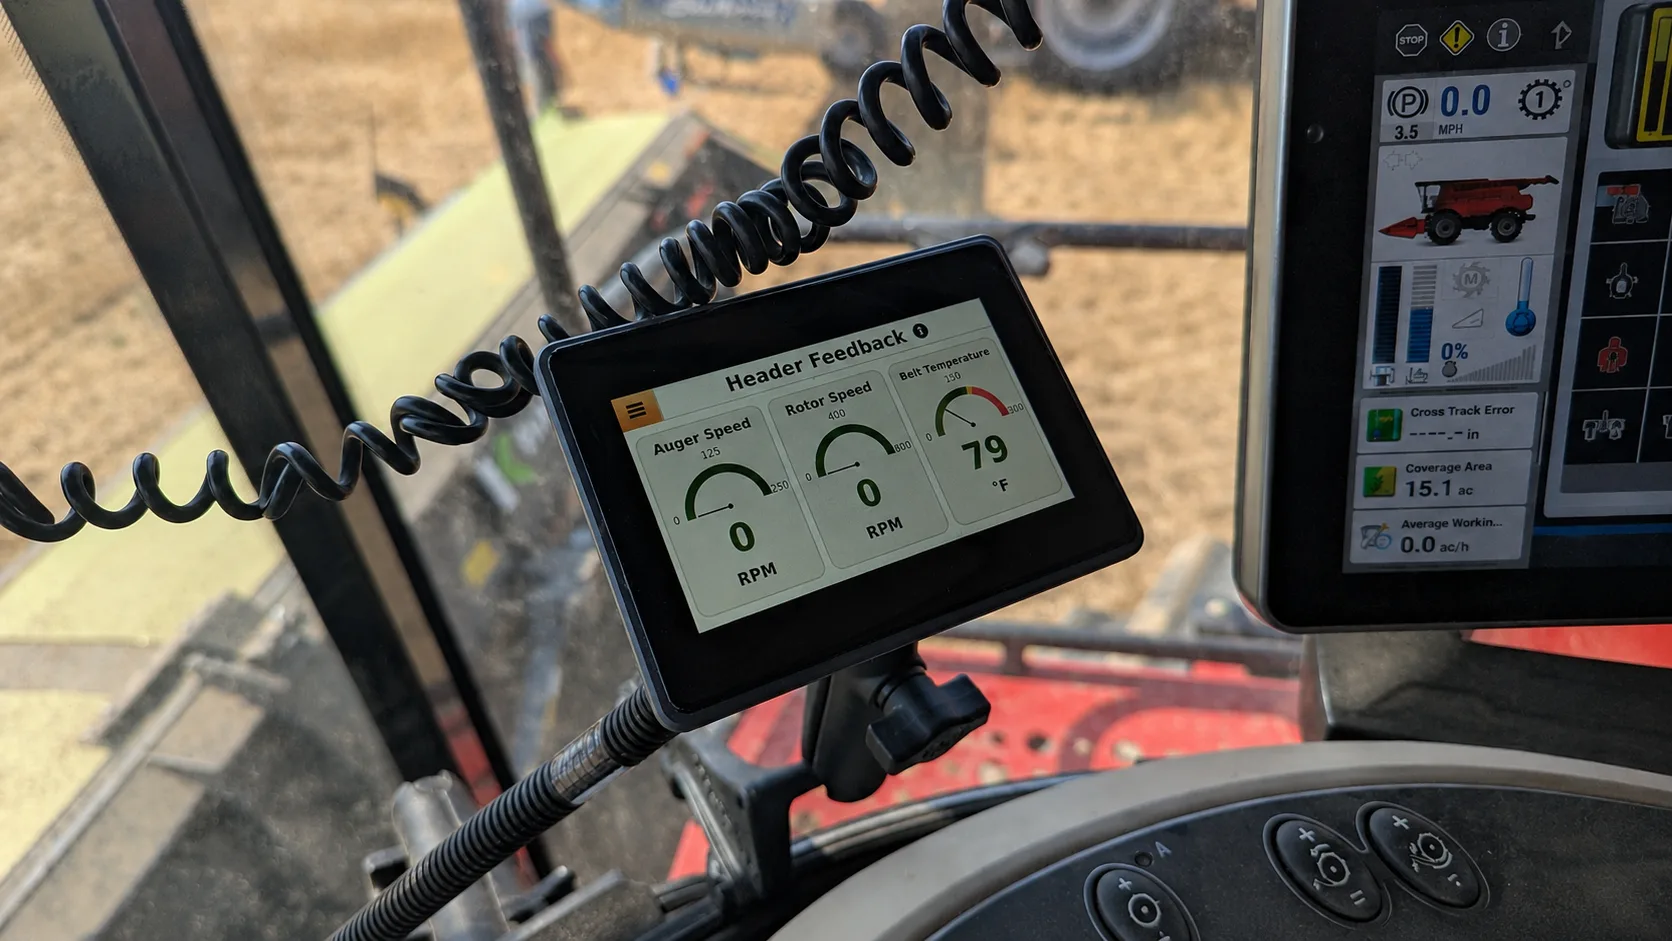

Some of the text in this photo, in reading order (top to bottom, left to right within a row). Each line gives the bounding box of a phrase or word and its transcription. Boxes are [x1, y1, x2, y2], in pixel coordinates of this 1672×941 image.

[1399, 35, 1424, 46] STOP
[1402, 93, 1417, 112] P
[1440, 84, 1492, 117] 0.0
[1534, 90, 1545, 109] 1
[1394, 124, 1419, 140] 3.5
[1438, 123, 1464, 136] MPH
[1465, 273, 1478, 286] M
[1441, 343, 1469, 359] 0%
[725, 329, 907, 392] Header Feedback
[899, 347, 991, 381] Belt Temperature
[944, 372, 962, 384] 150
[785, 381, 873, 417] Rotor Speed
[828, 409, 846, 421] 400
[1008, 403, 1025, 415] 300
[1410, 404, 1516, 418] Cross Track Error
[653, 417, 752, 459] Auger Speed
[925, 432, 933, 442] 0
[1467, 428, 1480, 441] in
[701, 446, 721, 460] 125
[894, 440, 912, 453] 800
[961, 434, 1009, 471] 79
[1406, 461, 1493, 476] Coverage Area
[805, 473, 813, 482] 0
[771, 480, 790, 494] 250
[856, 478, 882, 507] 0
[992, 478, 1009, 494] °F
[1405, 479, 1474, 498] 15.1 ac
[673, 516, 681, 526] 0
[866, 516, 904, 540] RPM
[1401, 517, 1449, 531] Average
[729, 521, 756, 552] 0
[1400, 535, 1470, 553] 0.0 ac/h
[737, 562, 778, 587] RPM
